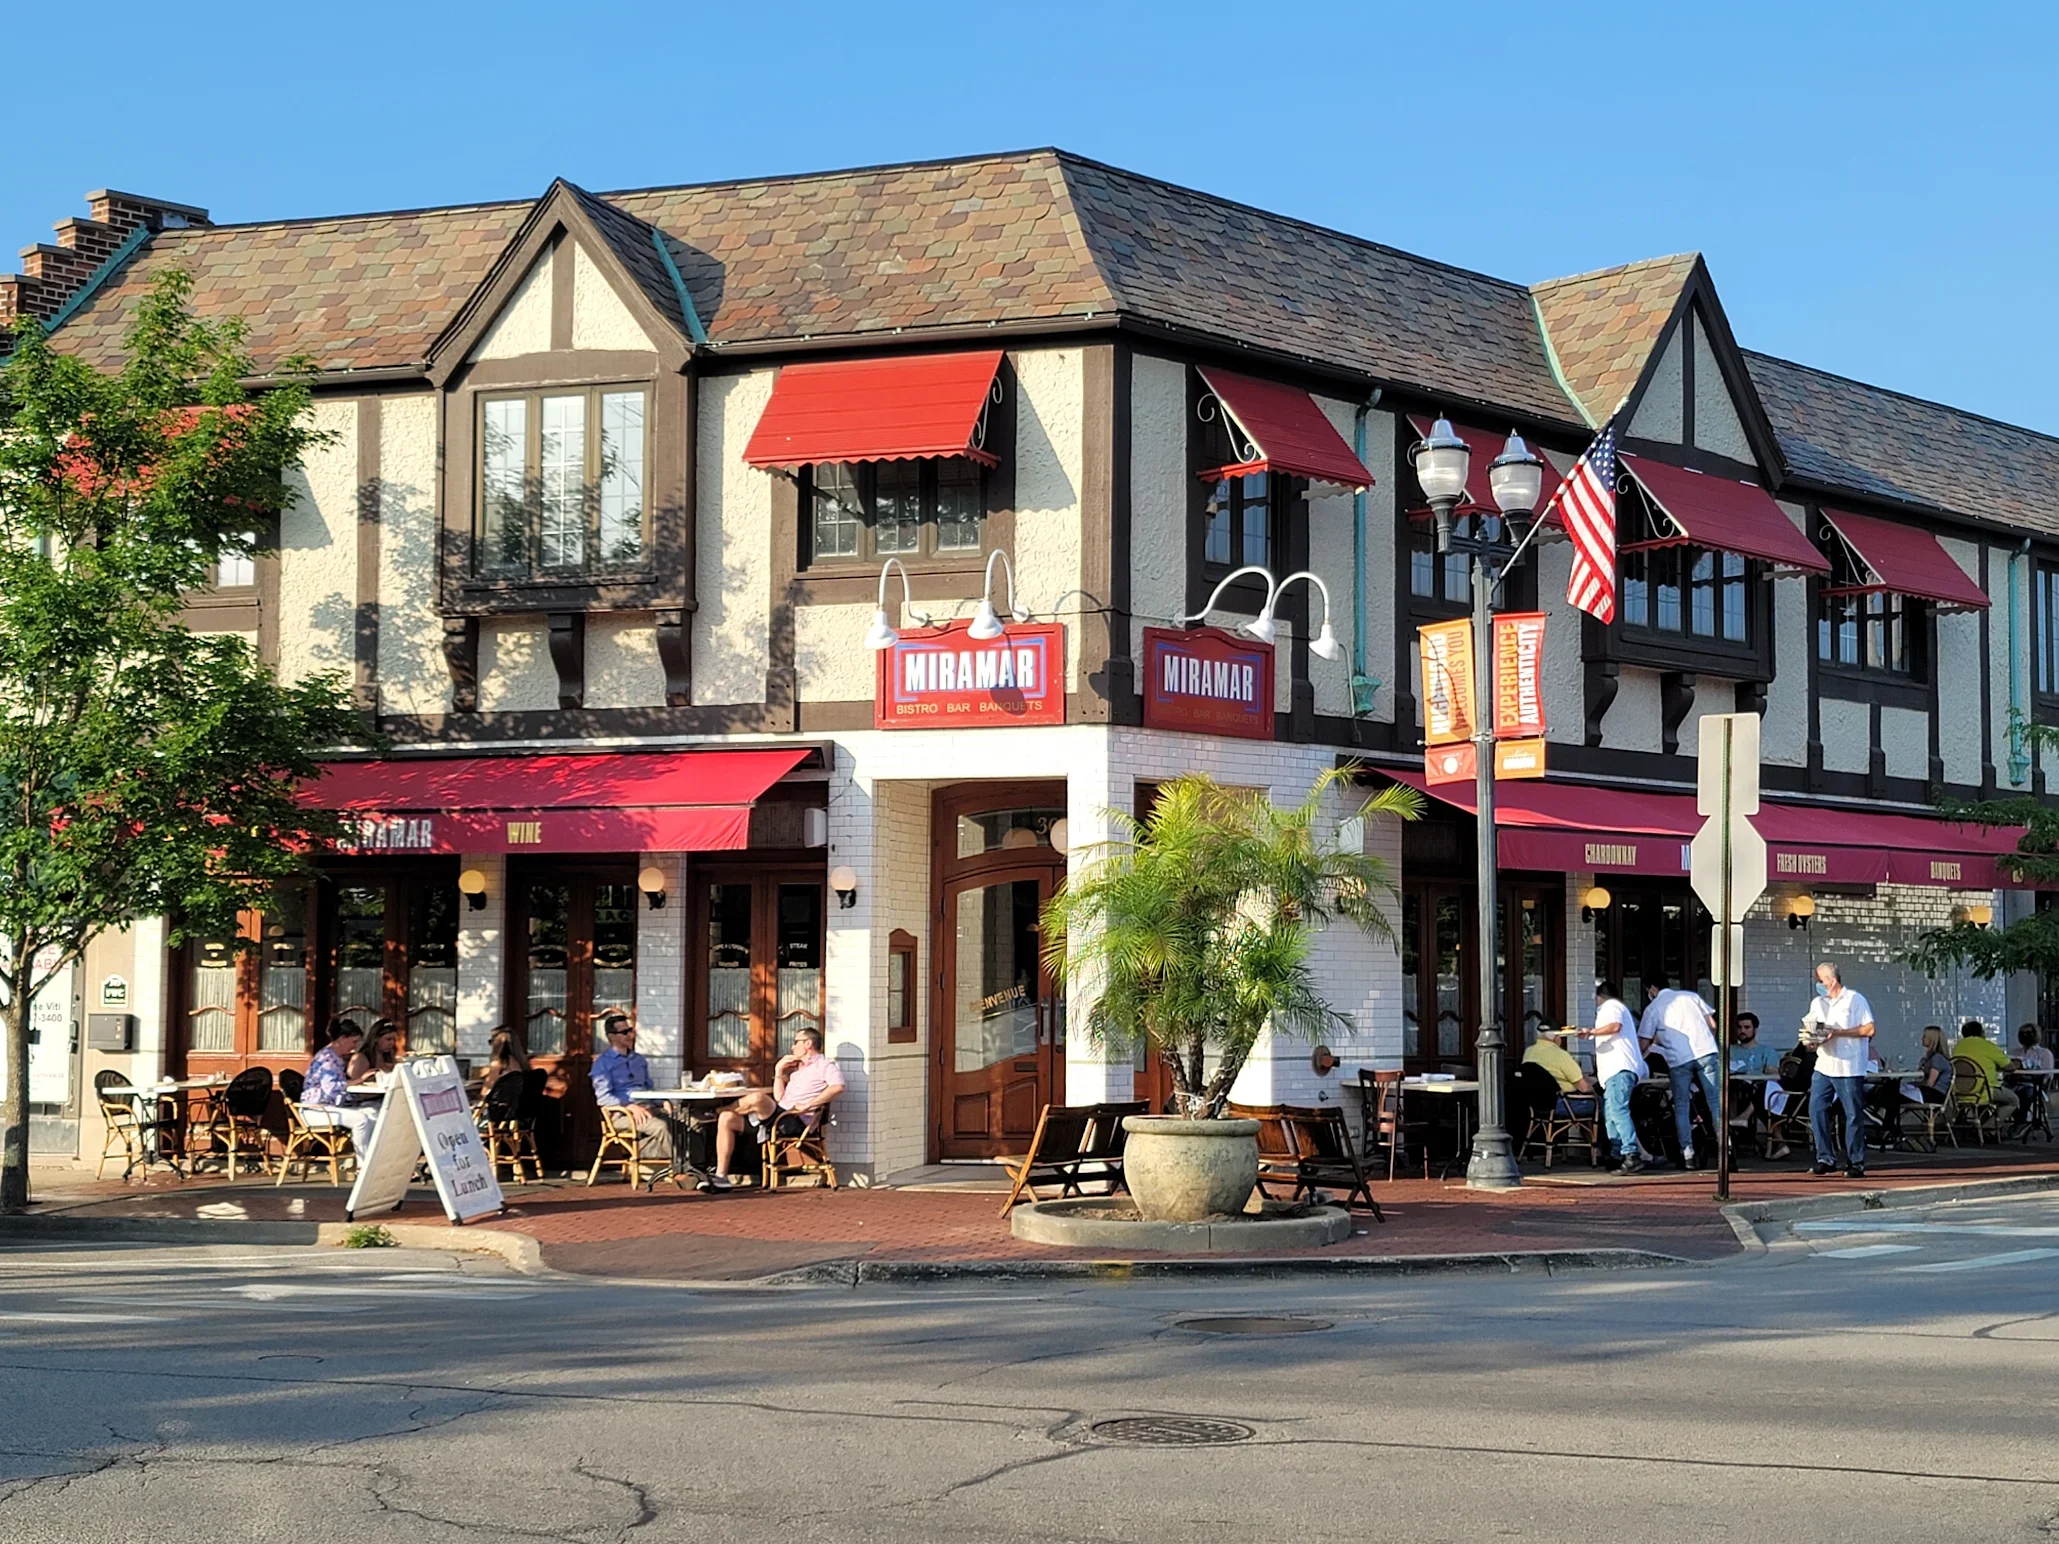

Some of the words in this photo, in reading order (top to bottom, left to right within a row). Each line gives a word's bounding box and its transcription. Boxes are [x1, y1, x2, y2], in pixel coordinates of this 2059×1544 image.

[1447, 630, 1465, 657] YOU
[905, 648, 1035, 692] MIRAMAR
[1164, 654, 1253, 702] MIRAMAR
[1499, 622, 1519, 727] EXPERIENCE
[1517, 623, 1539, 725] AUTHENTICITY
[1427, 632, 1451, 736] HIGHWOOD
[1450, 659, 1468, 731] WELCOMES
[896, 703, 939, 715] BISTRO
[947, 702, 971, 713] BAR
[979, 700, 1043, 713] BANQUETS
[1193, 708, 1211, 720] BAR
[1216, 711, 1259, 725] BANQUETS
[507, 821, 542, 844] WINE
[1584, 843, 1637, 866] CHARDONNAY
[1776, 853, 1797, 873] FRESH
[1797, 854, 1827, 875] OYSTERS
[437, 1131, 470, 1151] Open
[452, 1154, 471, 1171] for
[451, 1173, 489, 1198] Lunch
